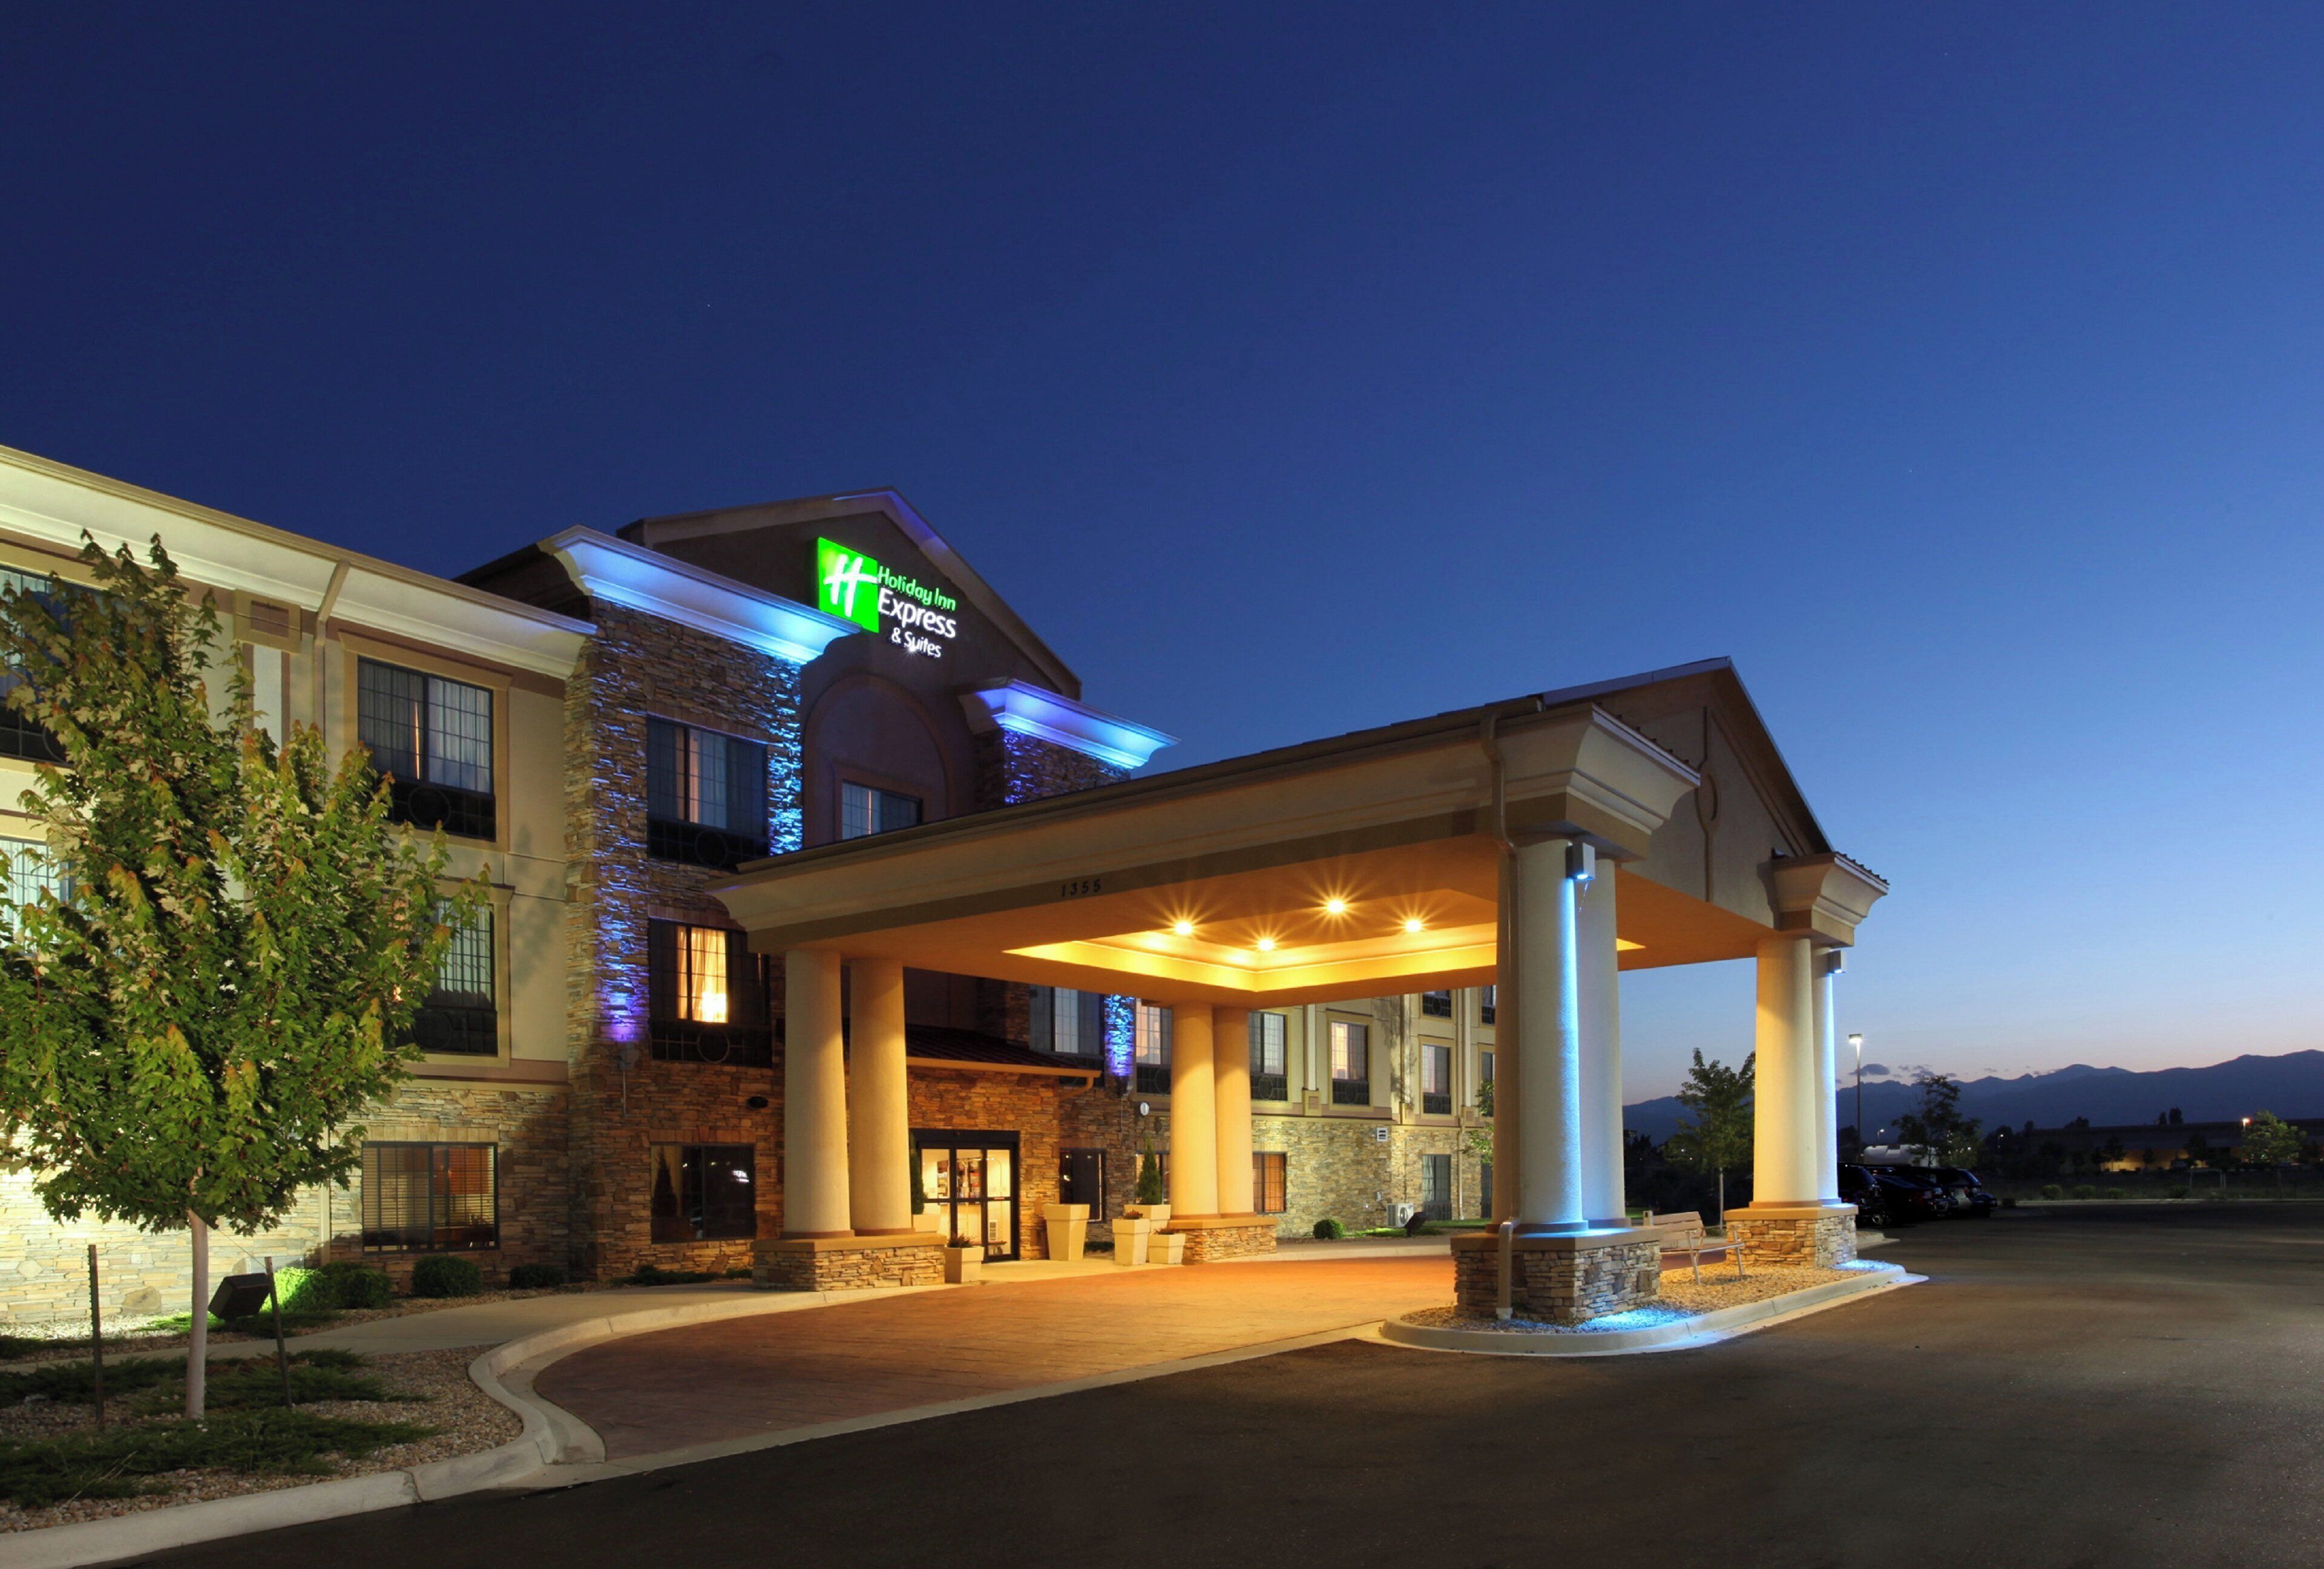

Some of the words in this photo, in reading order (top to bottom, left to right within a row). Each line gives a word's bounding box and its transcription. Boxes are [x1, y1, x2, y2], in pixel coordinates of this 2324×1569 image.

[879, 566, 933, 606] Holiday
[934, 588, 956, 611] Inn
[878, 587, 956, 638] Express
[891, 627, 901, 644] &
[904, 632, 942, 658] Suites
[1062, 879, 1101, 897] 1355
